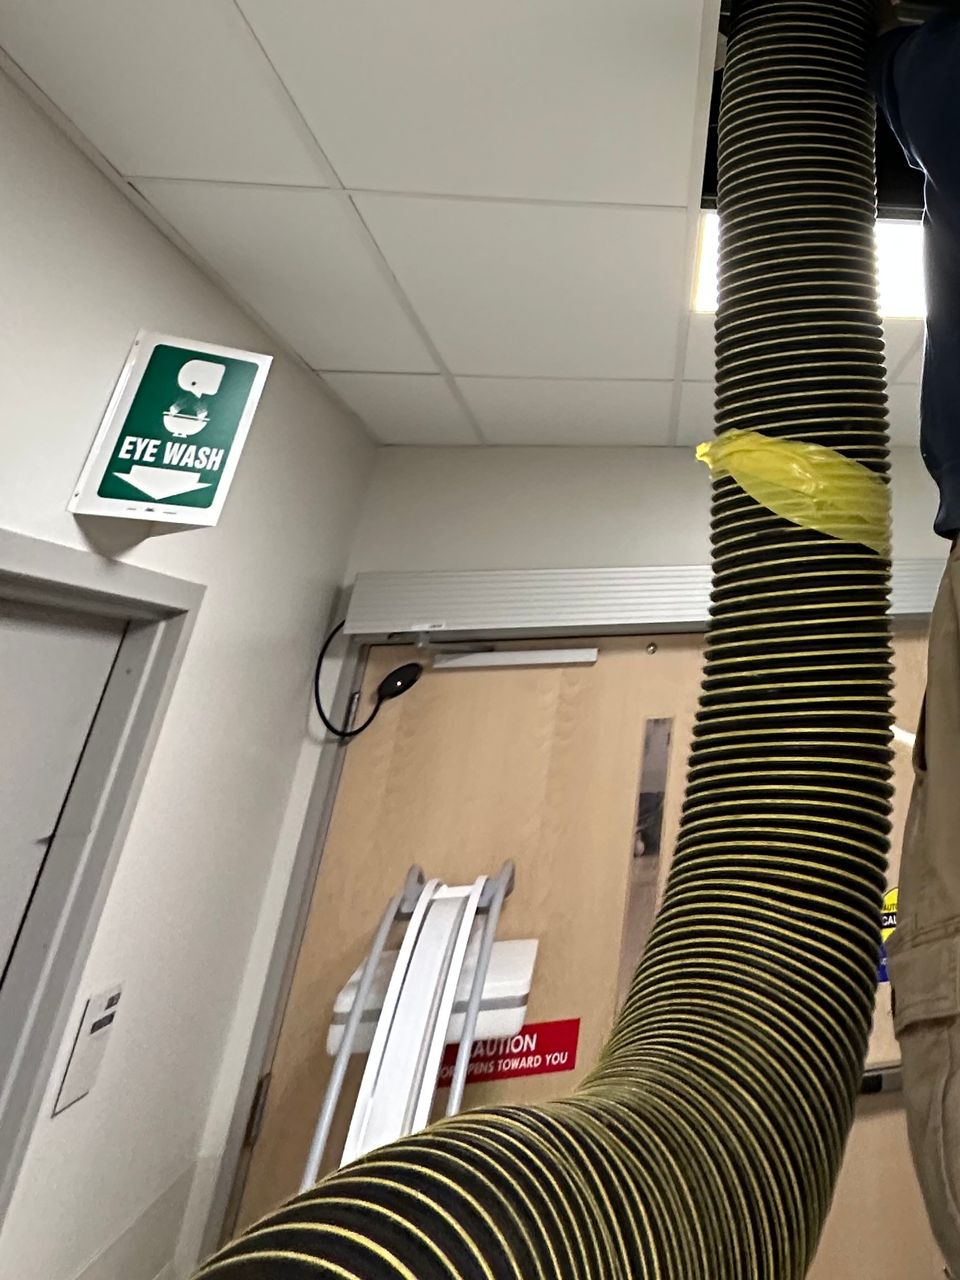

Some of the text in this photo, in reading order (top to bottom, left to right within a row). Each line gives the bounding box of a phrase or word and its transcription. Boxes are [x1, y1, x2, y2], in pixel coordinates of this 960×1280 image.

[118, 435, 225, 471] EYE WASH
[471, 1033, 537, 1058] AUTION
[468, 1061, 495, 1076] PENS
[498, 1055, 541, 1073] TOWARD
[545, 1051, 568, 1067] YOU
